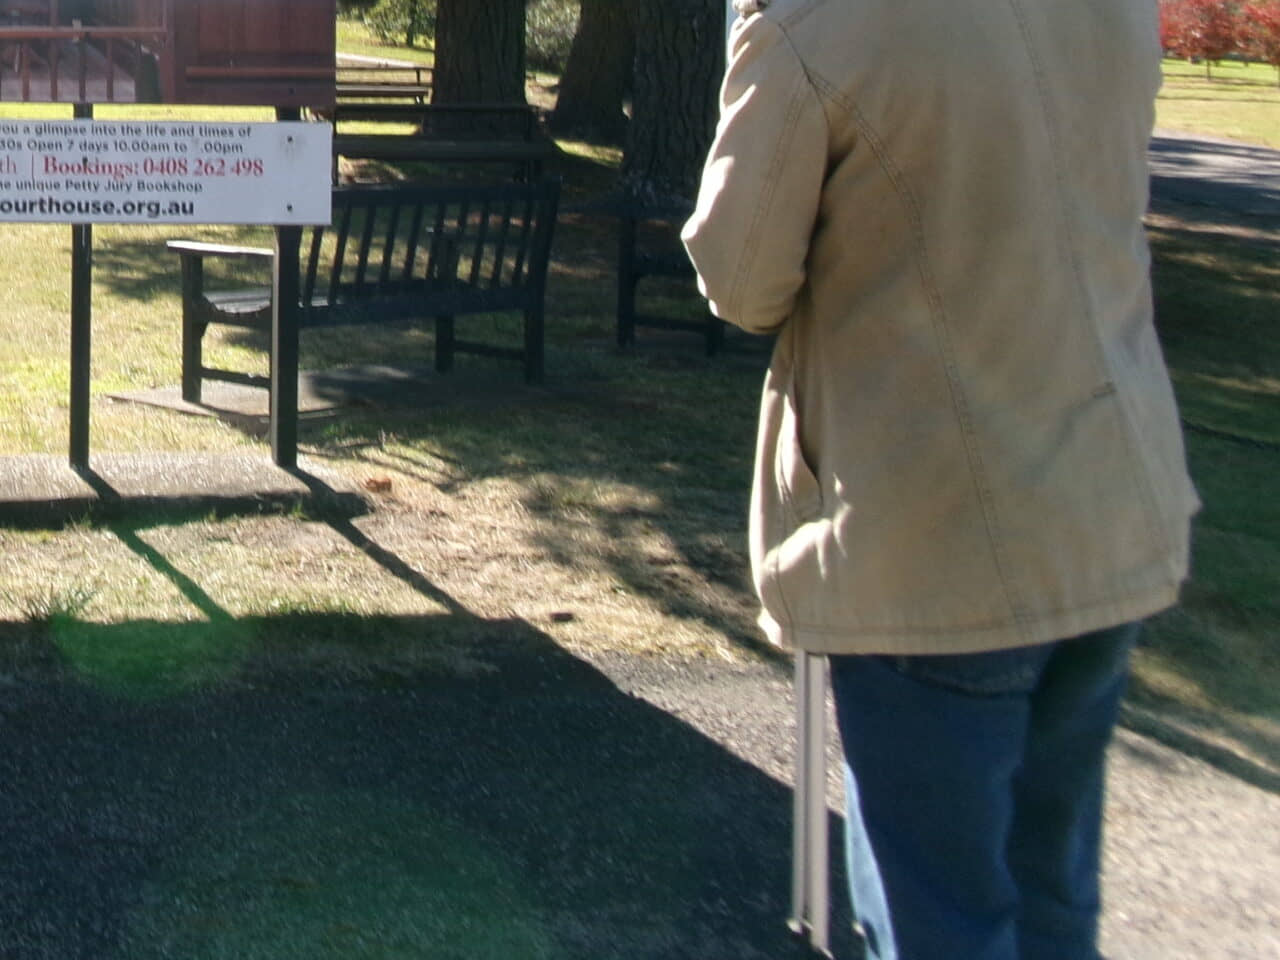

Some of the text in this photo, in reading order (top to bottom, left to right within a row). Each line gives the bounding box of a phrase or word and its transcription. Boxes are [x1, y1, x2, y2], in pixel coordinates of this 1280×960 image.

[23, 125, 31, 134] a
[35, 123, 87, 139] glimpse
[91, 123, 117, 136] into
[120, 124, 142, 137] the
[146, 124, 169, 137] life
[171, 125, 196, 137] and
[198, 125, 235, 138] times
[238, 126, 253, 138] of
[27, 139, 63, 153] Open
[67, 140, 75, 152] 7
[79, 140, 109, 154] days
[174, 142, 188, 153] to
[43, 156, 139, 180] Bookings:
[143, 157, 188, 176] 0408
[193, 158, 226, 177] 262
[230, 159, 264, 177] 498
[16, 179, 61, 194] unique
[65, 180, 99, 193] Petty
[103, 180, 132, 193] Jury
[136, 180, 203, 194] Bookshop
